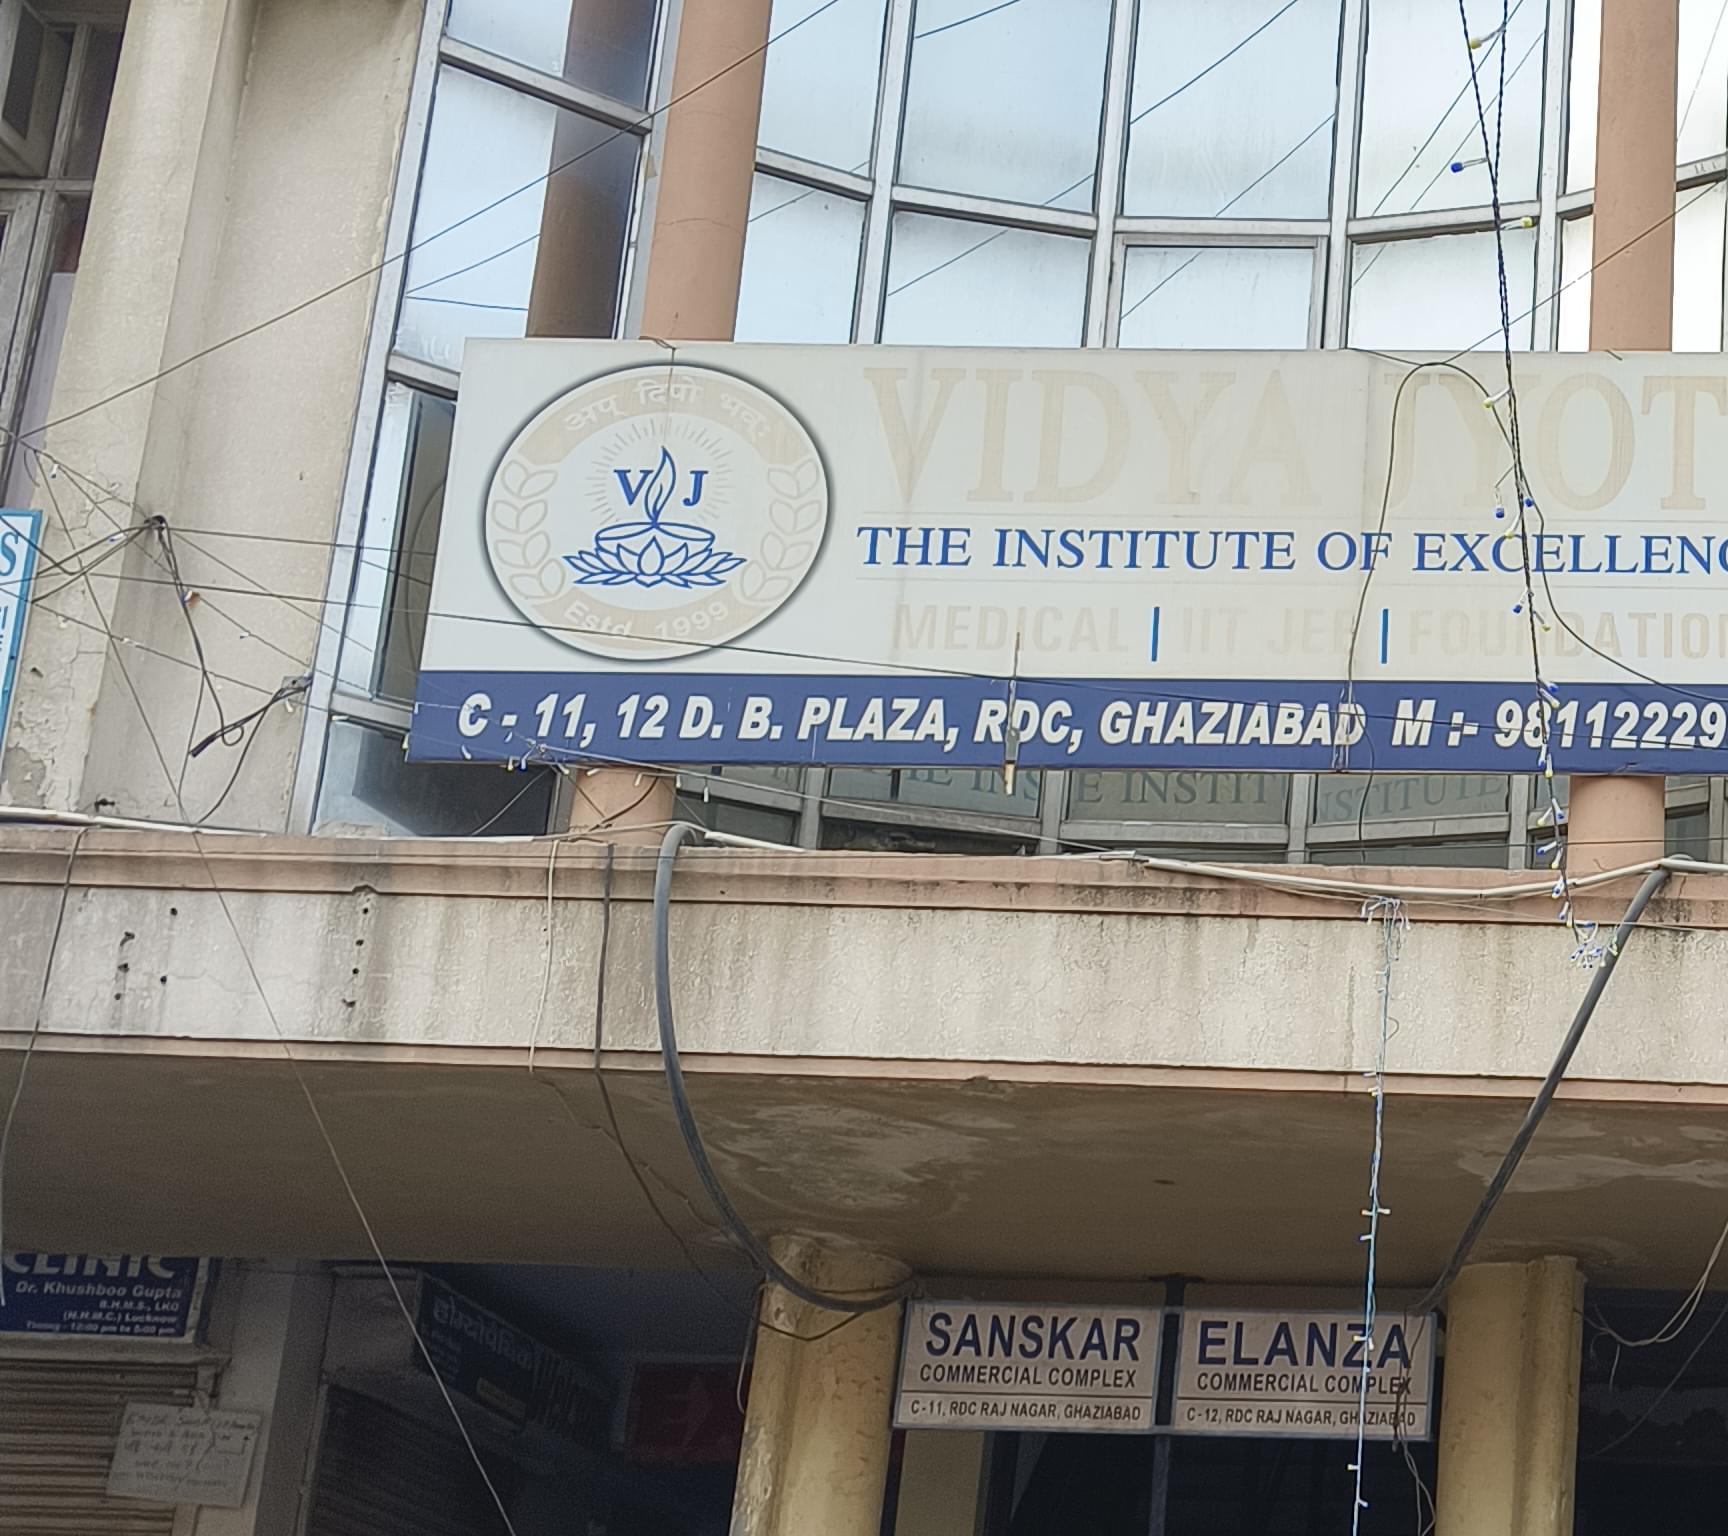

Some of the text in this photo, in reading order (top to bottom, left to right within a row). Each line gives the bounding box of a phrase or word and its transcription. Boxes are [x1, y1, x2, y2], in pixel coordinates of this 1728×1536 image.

[863, 367, 1322, 506] VIDYA
[856, 527, 972, 566] THE
[993, 529, 1296, 570] INSTITUTE
[1316, 531, 1393, 571] OF
[893, 604, 1128, 652] MEDICAL
[616, 694, 665, 738] 12
[798, 698, 959, 754] PLAZA,
[973, 699, 1083, 754] RDC,
[1100, 701, 1366, 747] GHAZIABAD
[43, 1282, 126, 1297] Khushboo
[132, 1285, 182, 1300] Gupta
[925, 1312, 1141, 1362] SANSKAR
[1199, 1320, 1413, 1370] ELANZA
[919, 1364, 1137, 1389] COMMERCIAL COMPLEX
[1197, 1372, 1412, 1396] COMMERCIAL COMPLEX
[950, 1400, 978, 1417] RDC
[980, 1401, 1007, 1418] RAJ
[1010, 1402, 1060, 1421] NAGAR,
[1063, 1404, 1141, 1422] GHAZIABAD
[1224, 1407, 1252, 1424] RDC
[1256, 1408, 1282, 1425] RAJ
[1286, 1409, 1337, 1428] NAGAR,
